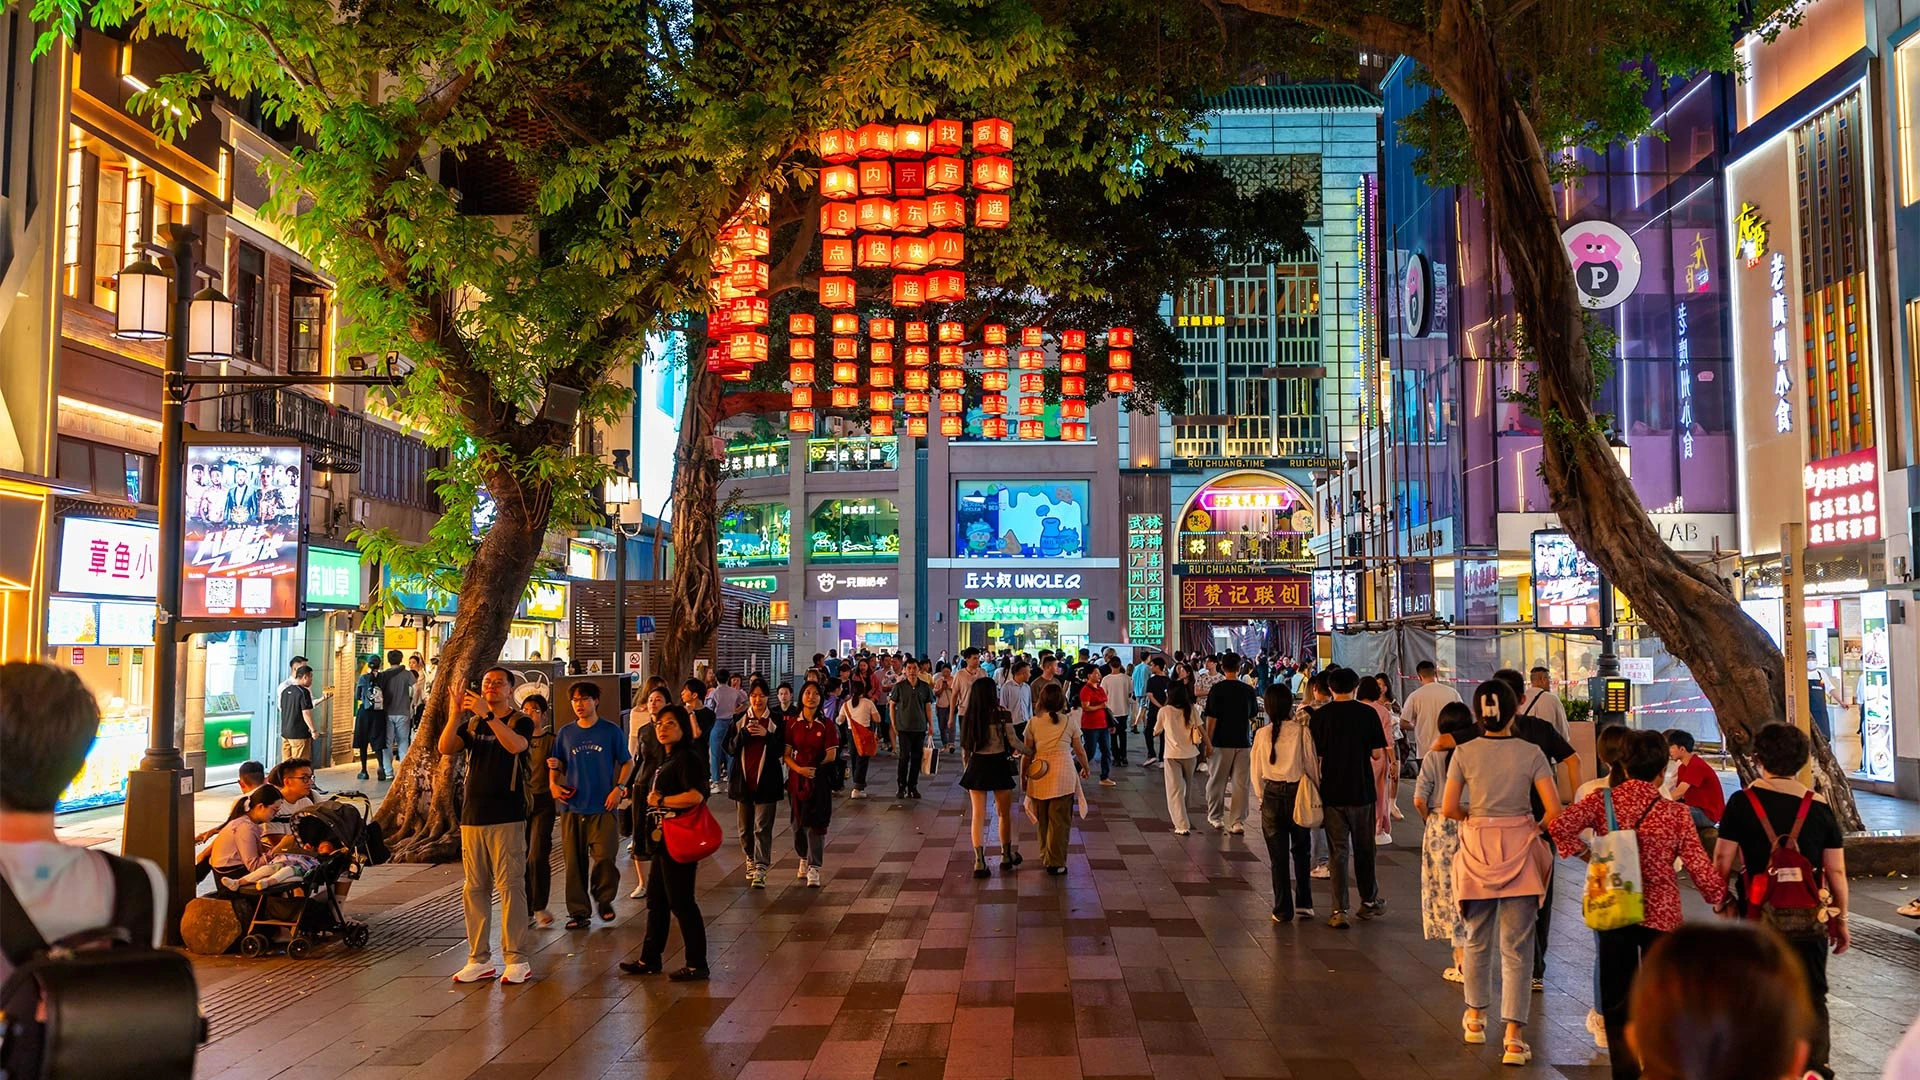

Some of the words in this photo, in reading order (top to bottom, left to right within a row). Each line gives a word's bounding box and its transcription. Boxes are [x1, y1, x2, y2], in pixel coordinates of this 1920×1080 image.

[734, 263, 752, 274] JDL
[756, 264, 768, 276] JDL
[1590, 266, 1608, 289] P
[732, 300, 751, 310] JDL
[753, 300, 768, 310] JDL
[732, 336, 750, 346] JDL
[754, 336, 767, 348] JDL
[1129, 514, 1163, 530] 武林
[1129, 534, 1163, 550] 厨神
[88, 539, 153, 579] 章鱼小
[1188, 566, 1204, 574] RUI
[964, 572, 1012, 588] 丘大叔
[1131, 553, 1145, 635] 广州人饮茶
[1147, 552, 1162, 634] 喜欢到厨神
